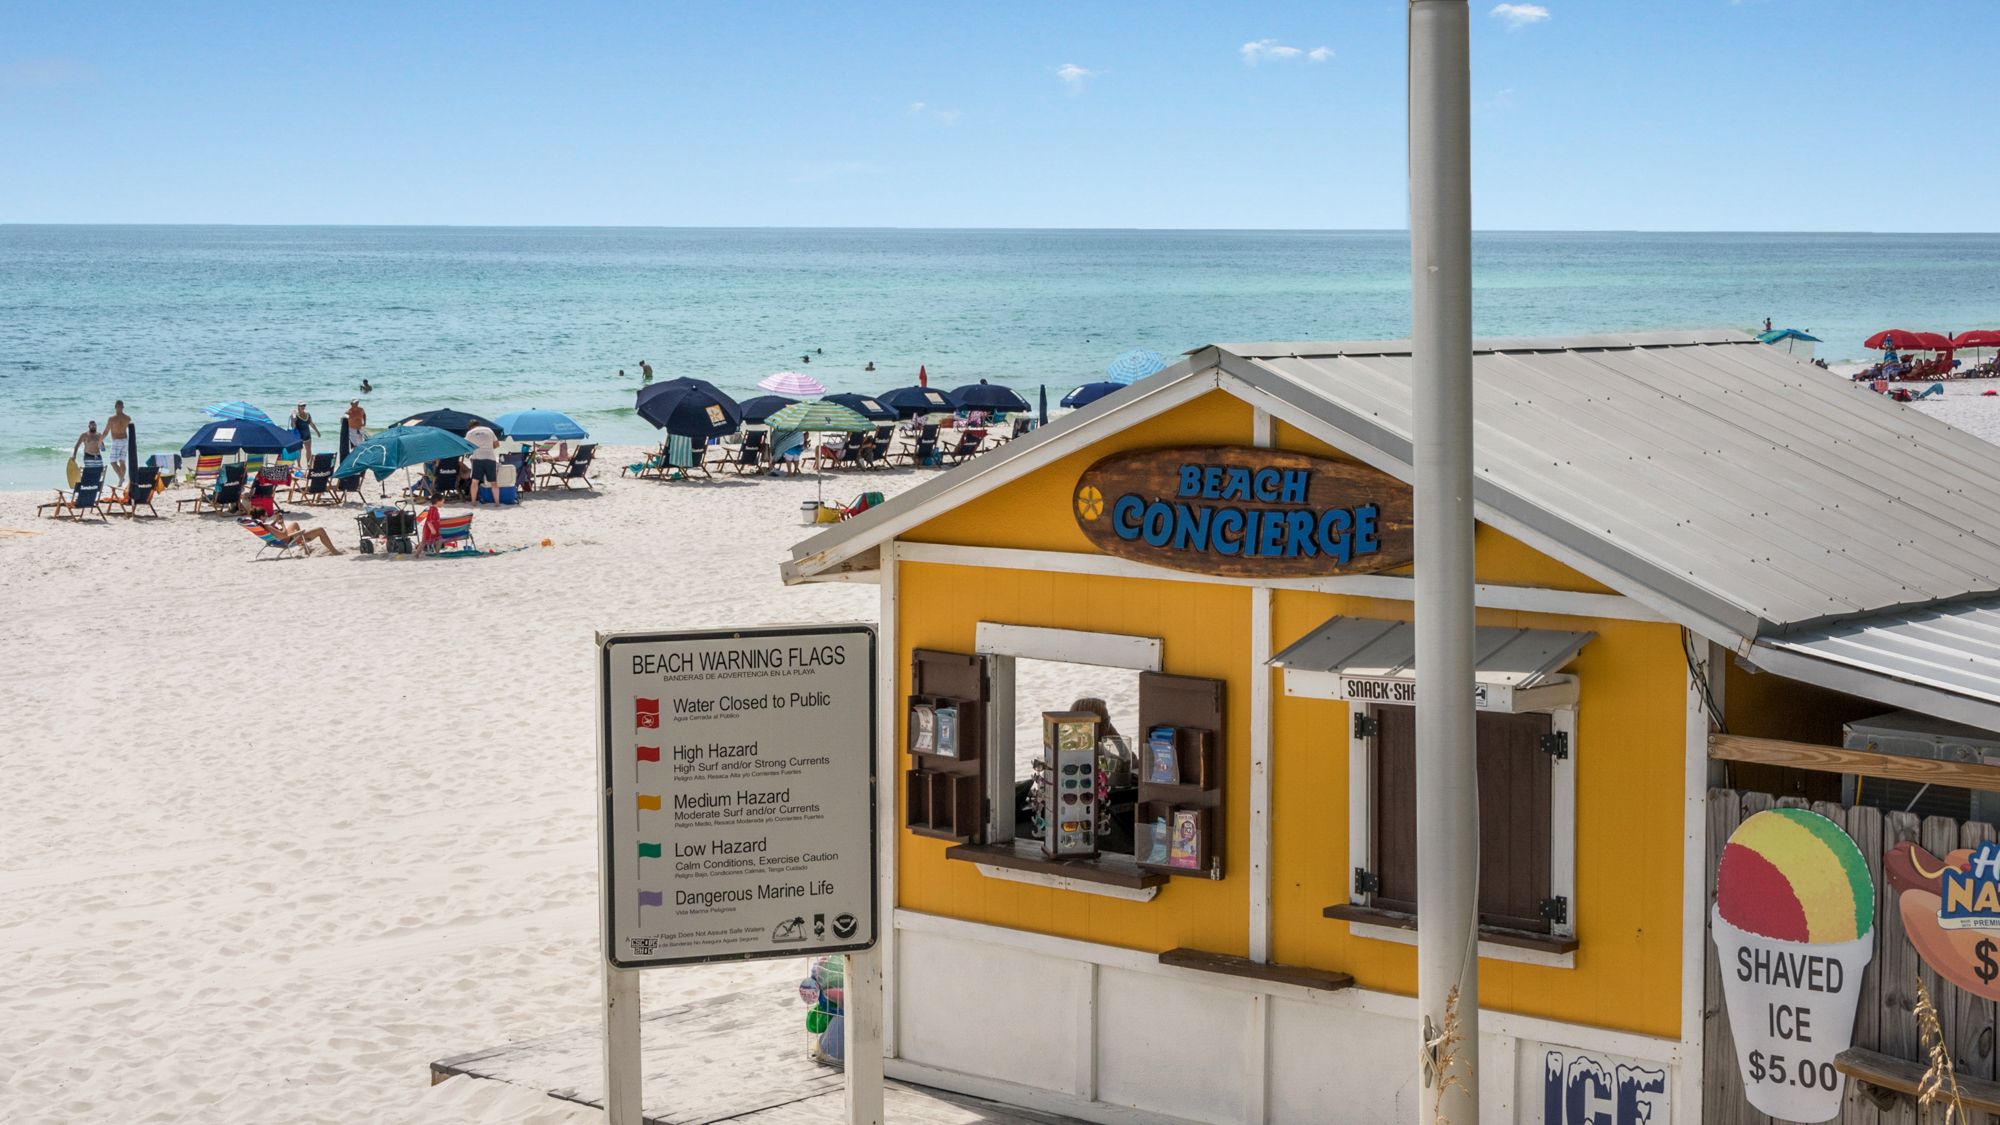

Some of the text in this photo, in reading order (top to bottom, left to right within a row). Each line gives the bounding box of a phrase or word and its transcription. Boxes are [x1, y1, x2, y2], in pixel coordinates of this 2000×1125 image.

[1177, 463, 1310, 504] BEACH
[1112, 493, 1380, 567] CONCIERGE
[631, 645, 846, 675] BEACH WARNING FLAGS
[663, 673, 704, 682] BANDERAS
[717, 670, 769, 679] ADVERTENCIA
[770, 669, 781, 677] EN
[793, 668, 816, 676] PLAYA
[673, 691, 831, 713] Water Closed to Public
[673, 741, 758, 763] High Hazard
[673, 756, 831, 774] High Surf and/or Strong Currents
[674, 787, 790, 809] Medium Hazard
[674, 803, 820, 821] Moderate Surf and/or Currents
[675, 837, 767, 857] Low Hazard
[675, 852, 839, 871] Calm Conditions, Exercise Caution
[675, 880, 834, 907] Dangerous Marine Life
[1947, 875, 2000, 913] NA
[1973, 919, 2000, 927] PREMI
[1736, 946, 1844, 993] SHAVED
[1768, 1002, 1812, 1042] ICE
[1748, 1049, 1838, 1092] $5.00
